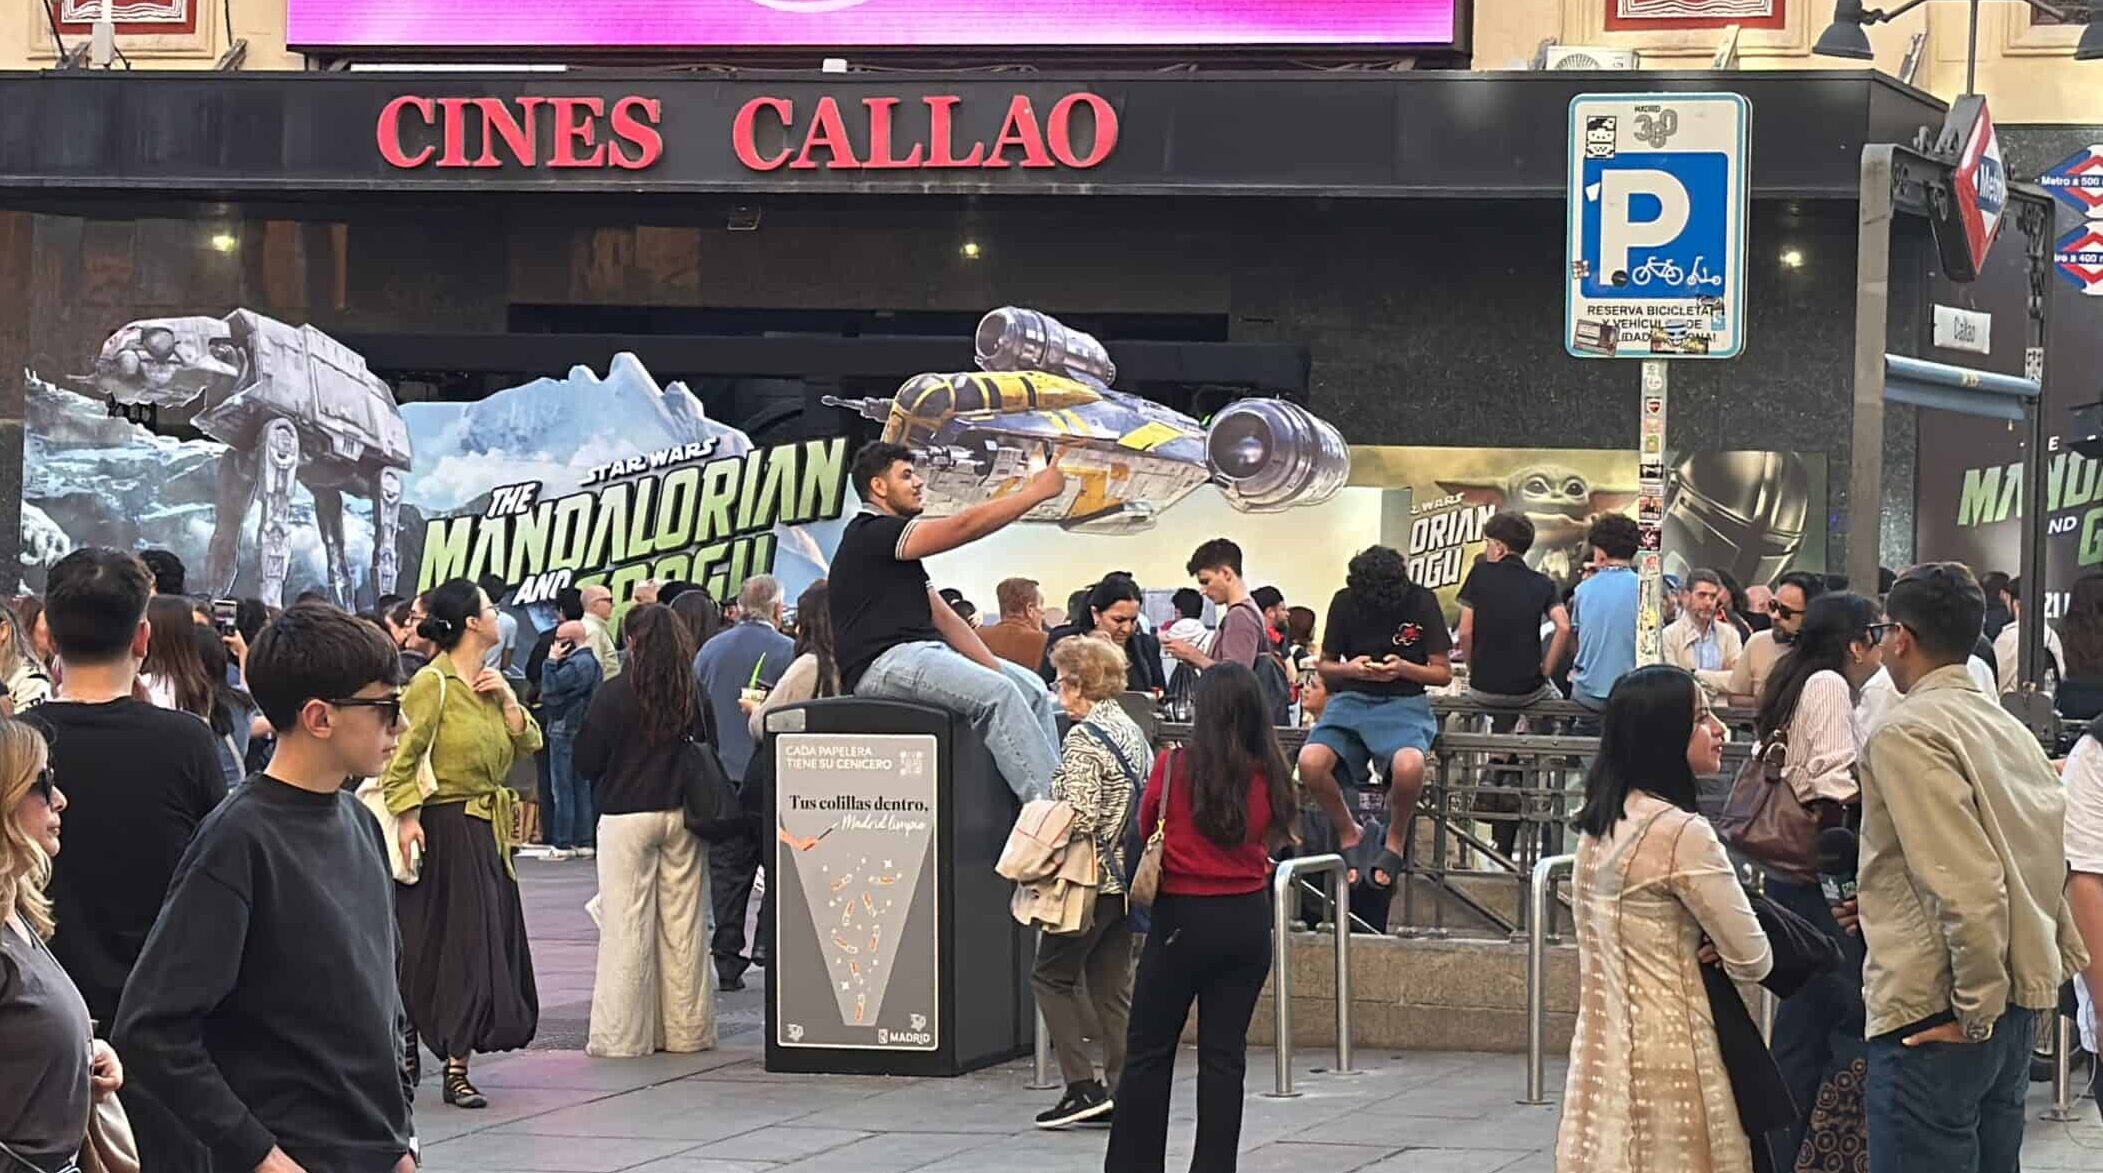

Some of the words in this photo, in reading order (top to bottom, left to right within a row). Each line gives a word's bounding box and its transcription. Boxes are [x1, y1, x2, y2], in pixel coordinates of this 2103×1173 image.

[376, 95, 663, 169] CINES
[732, 92, 1119, 169] CALLAO
[2041, 175, 2070, 186] Metro
[2072, 176, 2079, 186] a
[2081, 176, 2099, 186] 500
[1600, 169, 1690, 286] P
[1587, 305, 1643, 316] RESERVA
[579, 456, 647, 486] STAR
[648, 436, 718, 468] WARS
[488, 481, 541, 517] THE
[416, 437, 847, 596] MANDALORIAN
[2048, 516, 2078, 535] ND
[785, 745, 816, 756] CADA
[818, 746, 872, 757] PAPELERA
[786, 759, 817, 769] TIENE
[820, 759, 833, 769] SU
[836, 759, 893, 770] CENICERO
[788, 795, 816, 811] Tus
[819, 795, 872, 811] colillas
[841, 813, 889, 830] Madrid
[889, 1032, 931, 1044] MADRID
